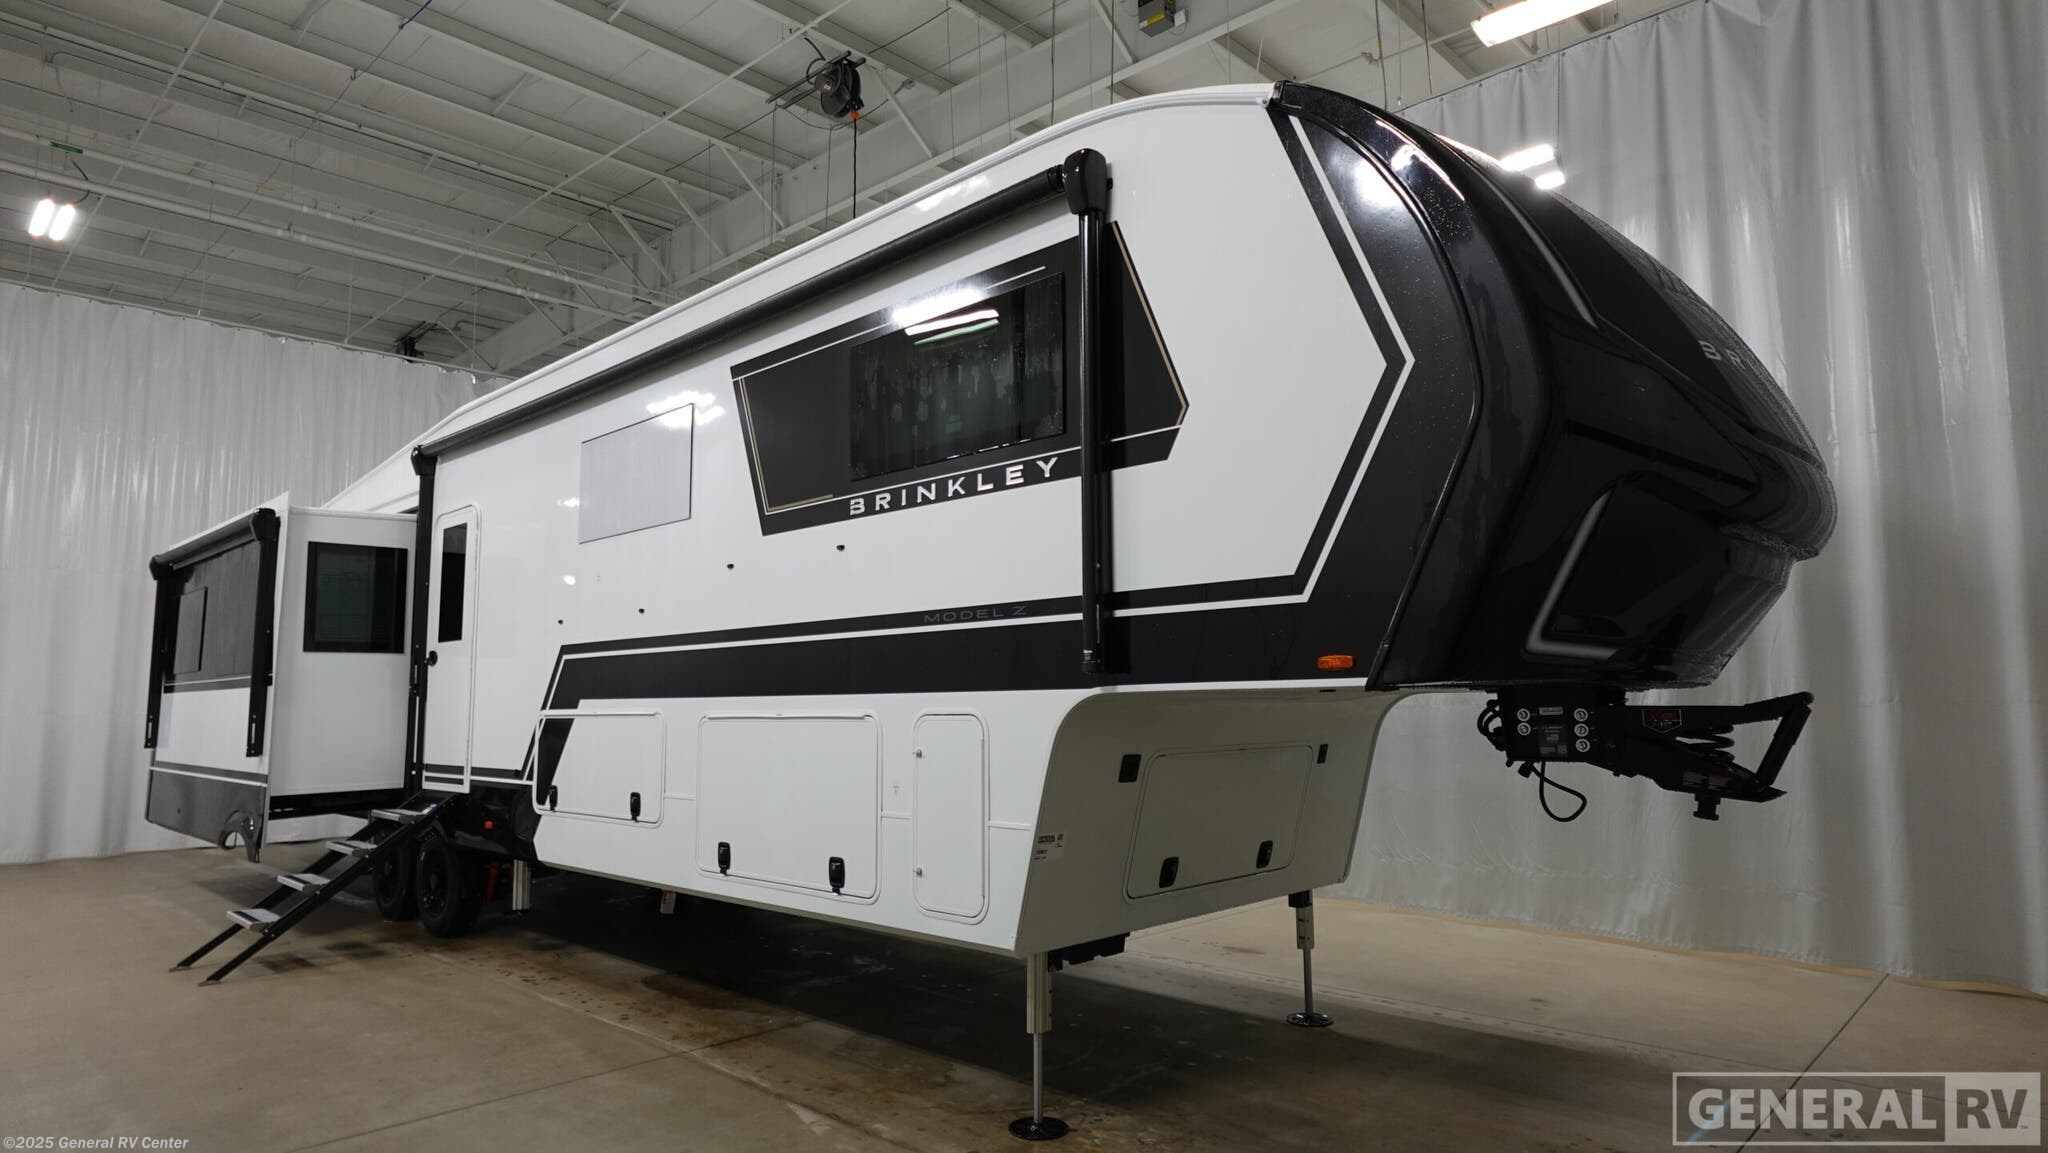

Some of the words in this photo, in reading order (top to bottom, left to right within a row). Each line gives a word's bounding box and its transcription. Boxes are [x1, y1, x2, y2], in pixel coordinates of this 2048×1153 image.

[849, 456, 1059, 516] BRINKLEY
[924, 607, 1005, 624] MODEL
[1012, 605, 1028, 617] Z
